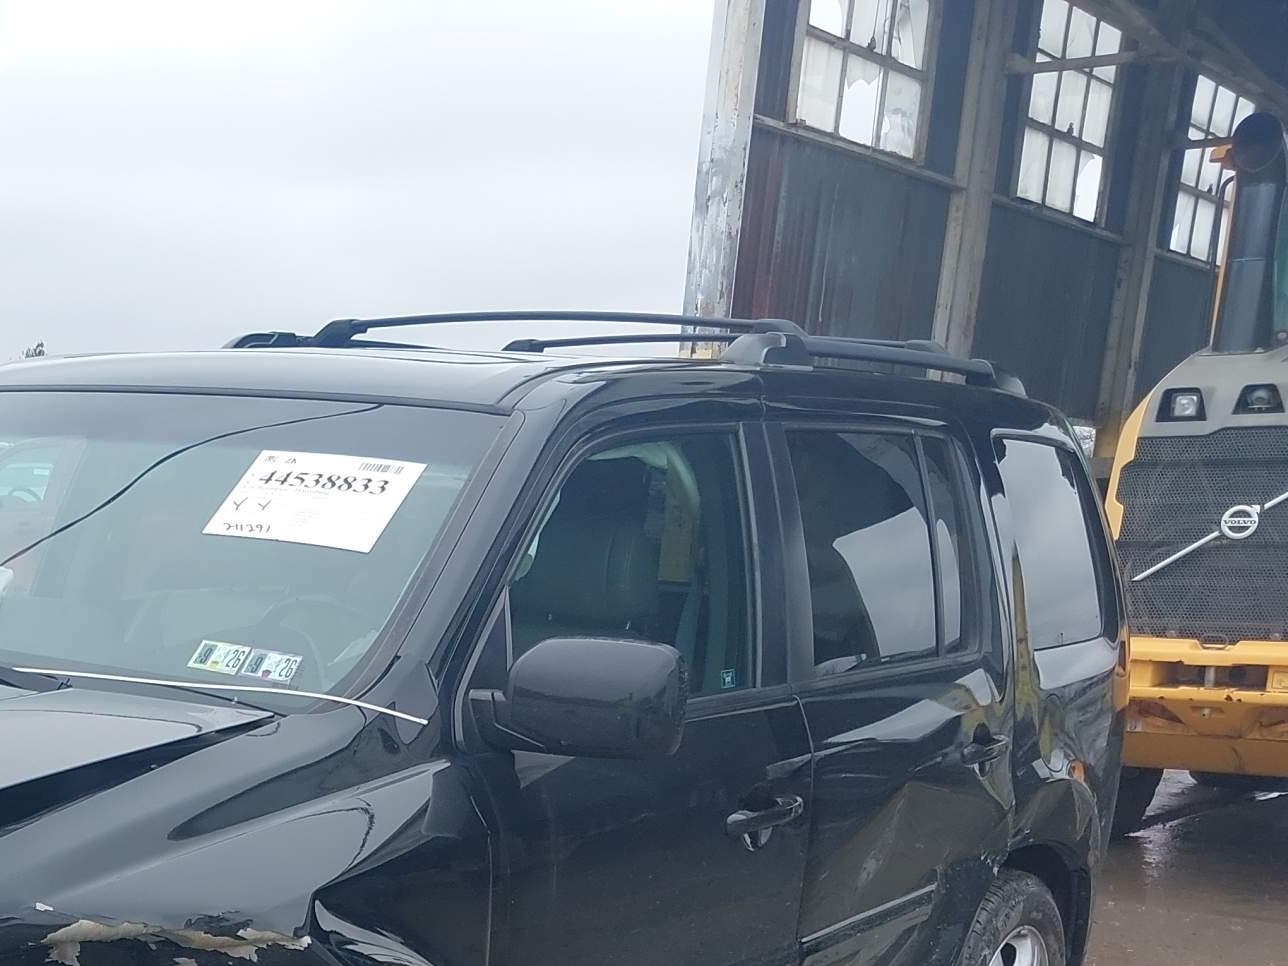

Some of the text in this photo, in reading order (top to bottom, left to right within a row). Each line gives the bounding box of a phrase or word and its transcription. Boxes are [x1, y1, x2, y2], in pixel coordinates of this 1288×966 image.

[259, 470, 390, 496] 44538833
[199, 647, 246, 668] 9 26
[251, 656, 298, 678] 9 26
